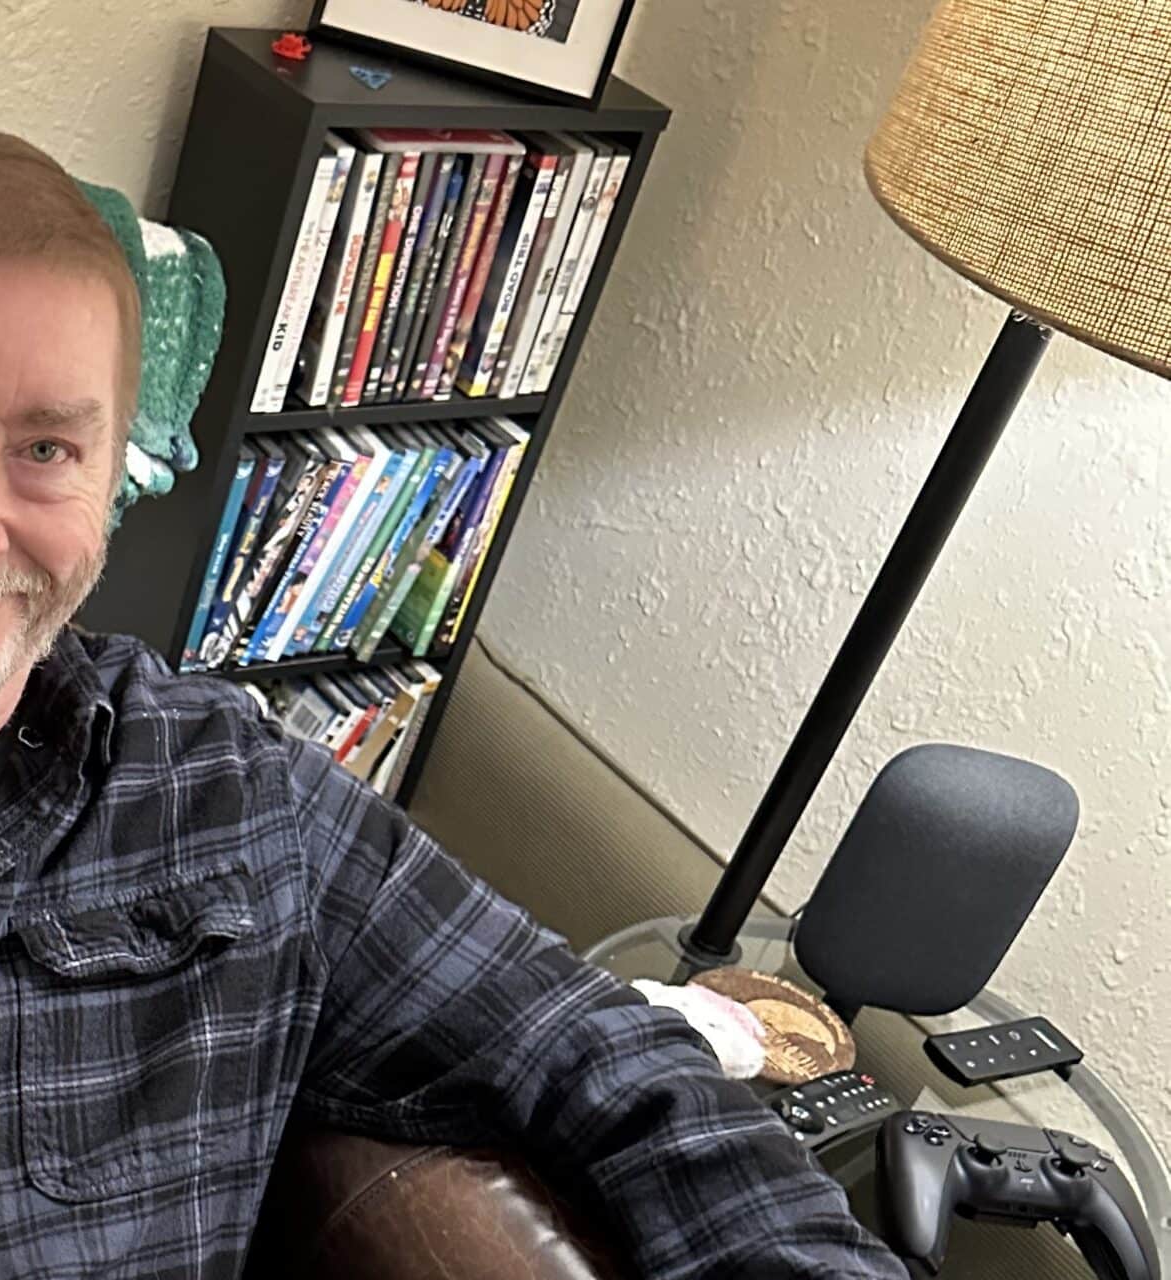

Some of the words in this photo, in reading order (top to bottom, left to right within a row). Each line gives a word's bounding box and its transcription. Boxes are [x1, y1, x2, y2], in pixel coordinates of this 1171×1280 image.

[407, 204, 422, 235] ONE
[280, 237, 311, 321] HEARTBREAK
[387, 236, 414, 309] DIRECTION
[499, 270, 519, 314] ROAD
[514, 232, 531, 268] TRIP
[271, 321, 287, 352] KID
[314, 469, 338, 502] BLACK
[294, 500, 320, 537] BEAUTY
[331, 581, 361, 626] WIZARD
[359, 555, 375, 574] OZ
